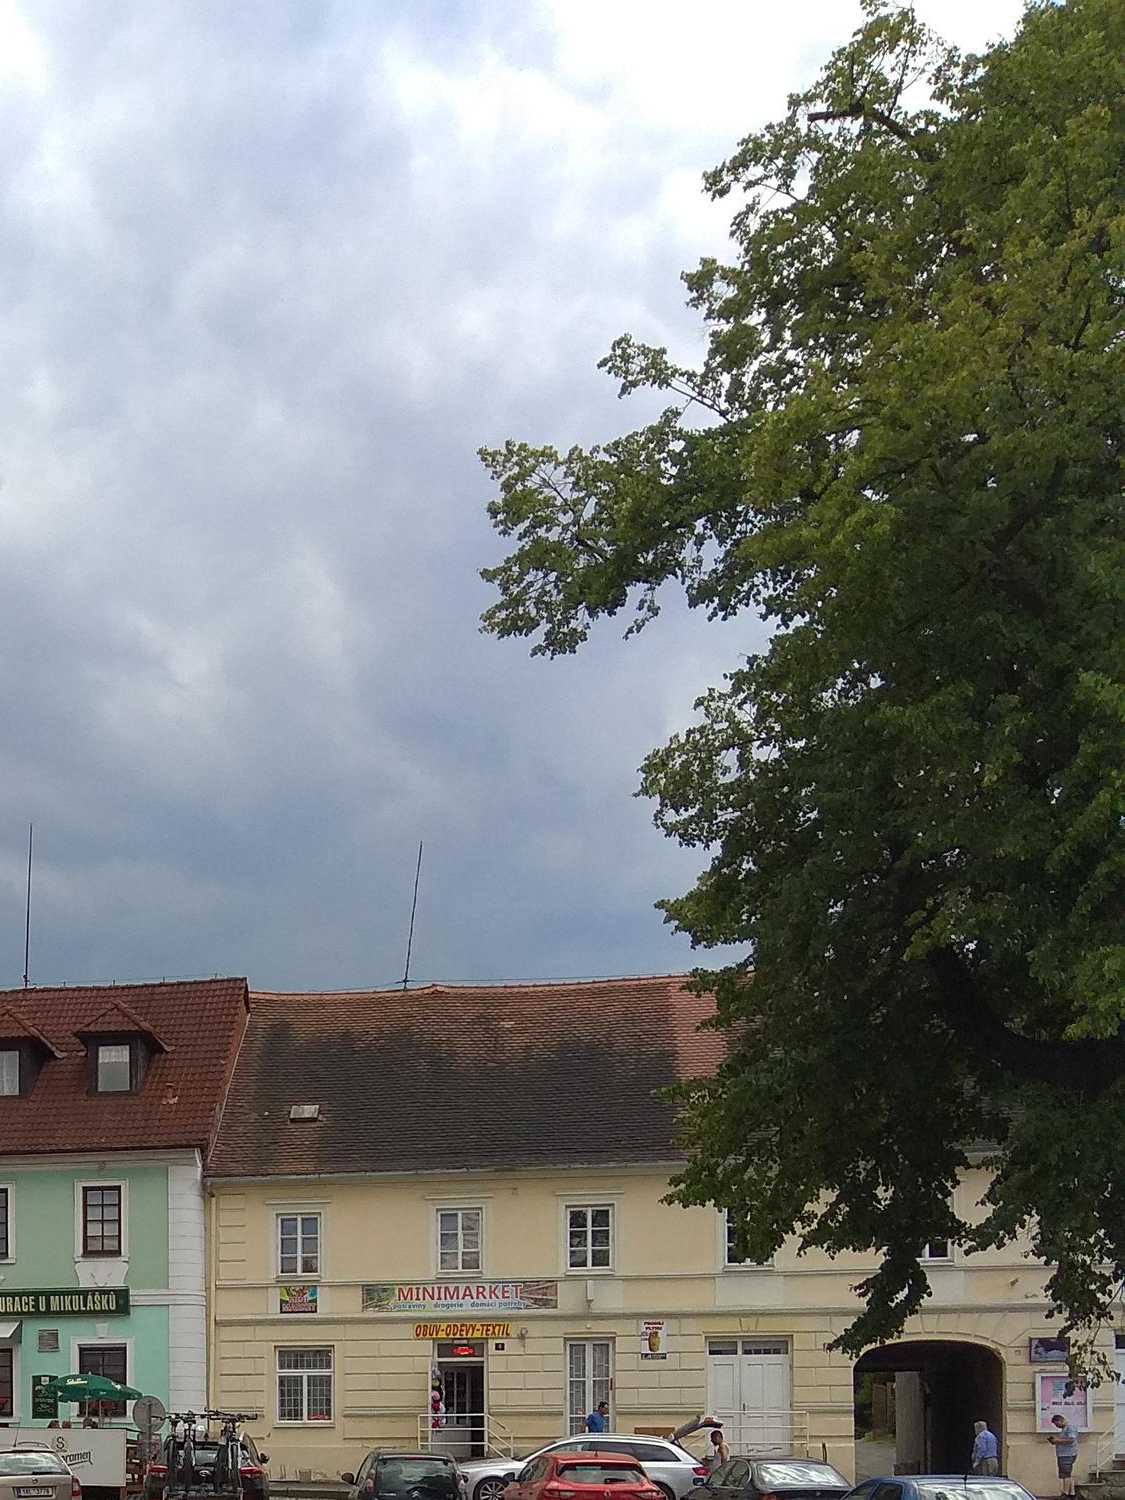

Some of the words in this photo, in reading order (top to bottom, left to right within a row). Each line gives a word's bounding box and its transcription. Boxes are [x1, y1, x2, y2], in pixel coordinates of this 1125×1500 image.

[397, 1284, 522, 1301] MINIMARKET
[39, 1295, 46, 1312] U
[393, 1302, 426, 1311] potraviny
[433, 1301, 463, 1310] drogerie
